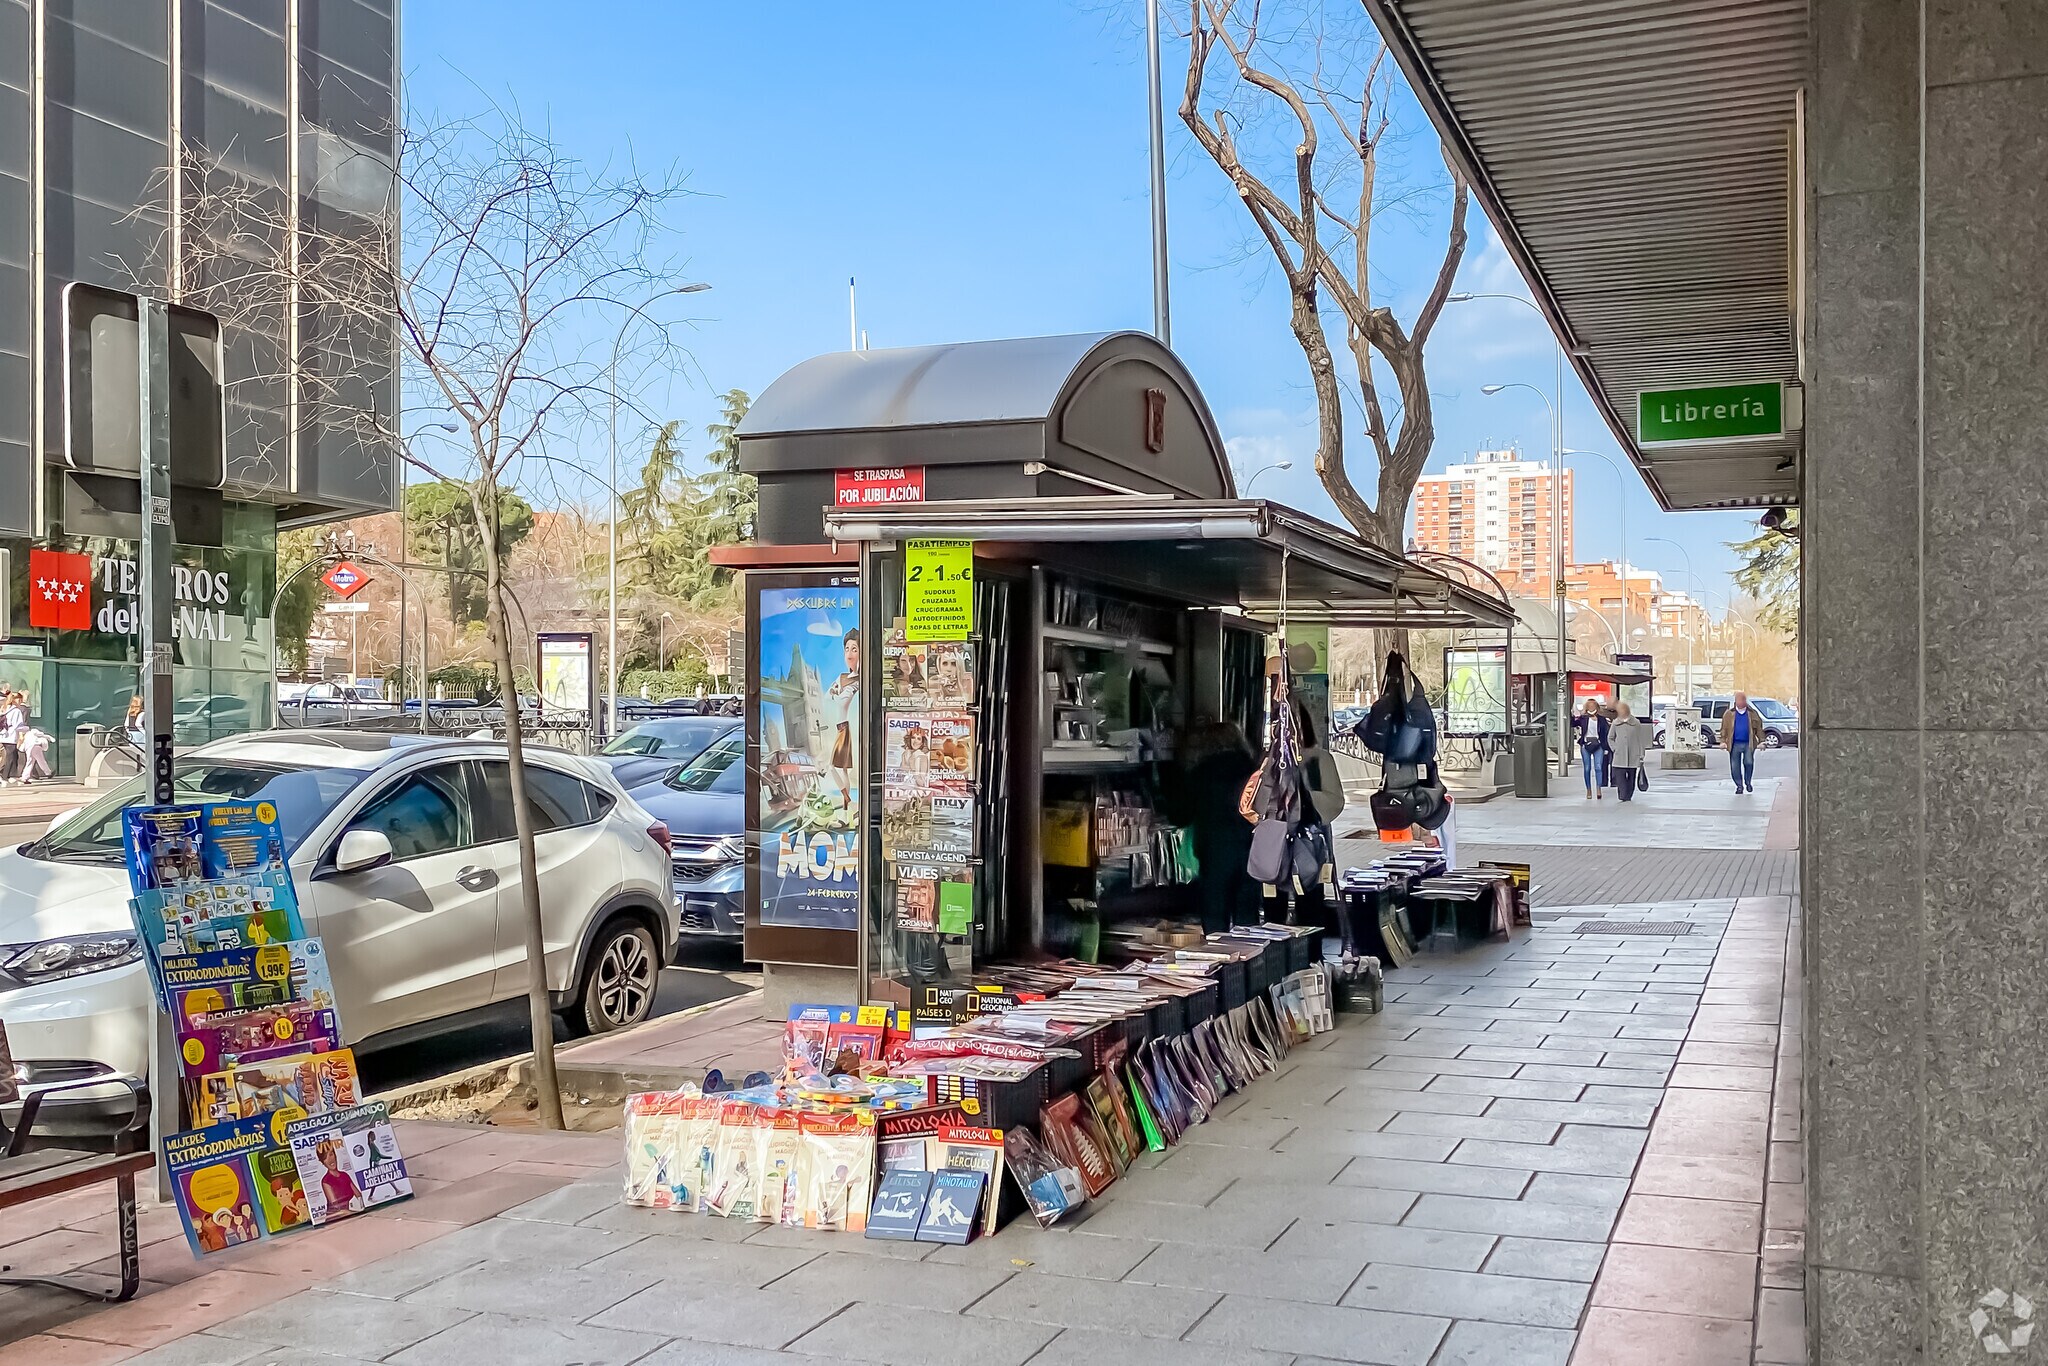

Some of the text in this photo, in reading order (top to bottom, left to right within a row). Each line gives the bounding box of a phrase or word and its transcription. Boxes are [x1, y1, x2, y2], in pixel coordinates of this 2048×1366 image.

[1660, 397, 1765, 423] Librería
[854, 469, 905, 481] SE TRASPASA
[839, 484, 920, 503] POR JUBILACIÓN
[908, 540, 970, 549] PASATIEMPOS
[334, 574, 354, 583] Metro
[908, 565, 923, 582] 2
[102, 557, 230, 605] TEROS
[787, 597, 854, 609] DESCUBRE UN
[943, 651, 971, 661] SANA
[889, 719, 921, 729] SABER
[933, 798, 968, 810] muy
[897, 849, 967, 863] REVISTA+AGEND
[898, 865, 939, 880] VIAJES
[897, 919, 932, 928] JORDANIA
[164, 957, 198, 971] MUJERES
[166, 963, 250, 983] EXTRAORDINARIAS
[939, 996, 953, 1004] GEO
[981, 996, 1013, 1006] NATIONAL
[917, 1008, 943, 1017] PAÍSES
[287, 1103, 385, 1134] ADELGAZA CAMINANDO
[885, 1110, 967, 1135] MITOLOGÍA
[166, 1132, 206, 1151] MUJERES
[293, 1133, 330, 1150] SABER
[948, 1129, 990, 1141] MITOLOGÍA
[168, 1130, 266, 1166] EXTRAORDINARIAS
[317, 1138, 344, 1154] VIVIR
[947, 1154, 990, 1170] HÉRCULES
[937, 1175, 979, 1189] MINOTAURO
